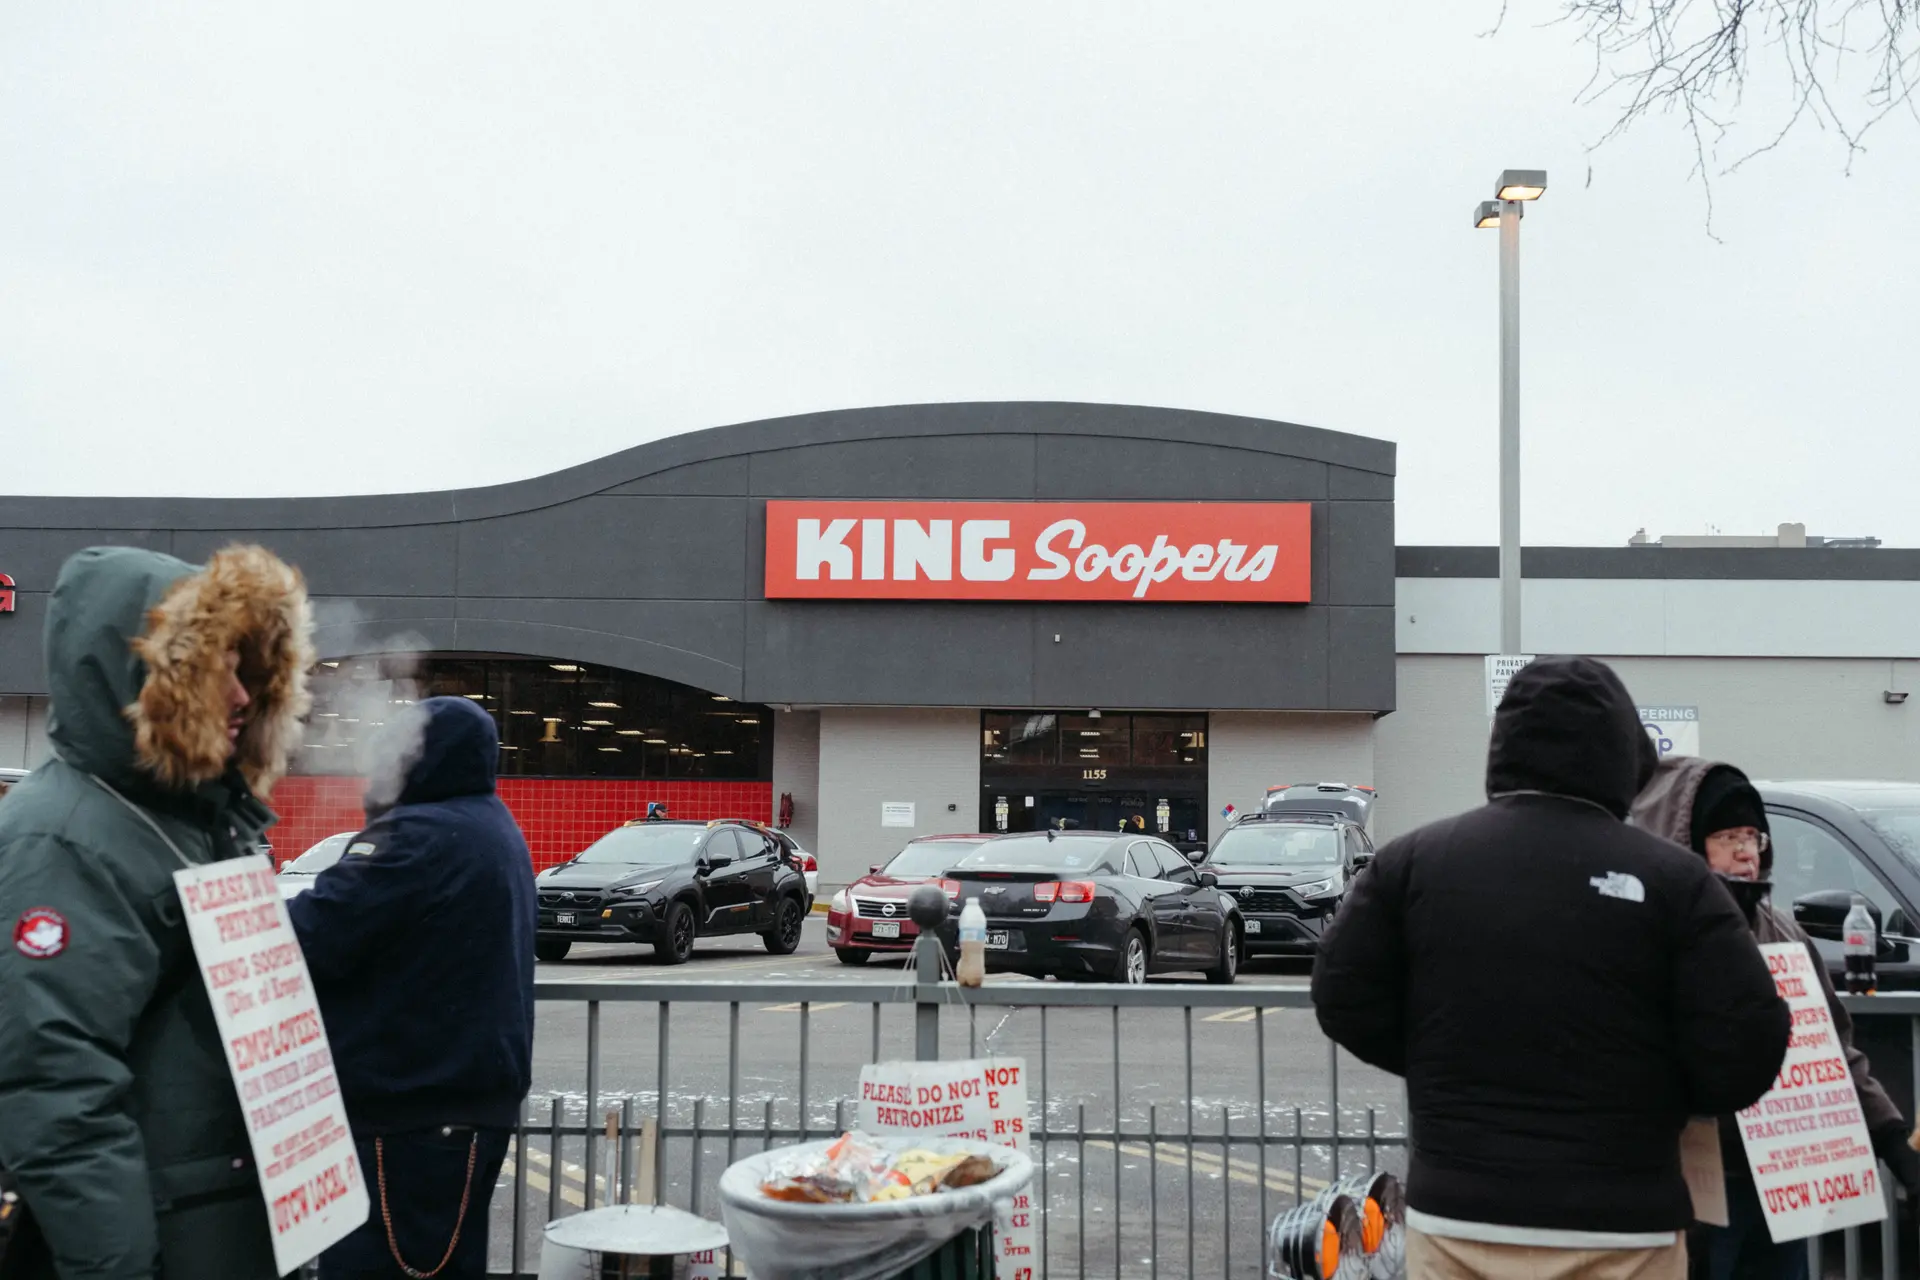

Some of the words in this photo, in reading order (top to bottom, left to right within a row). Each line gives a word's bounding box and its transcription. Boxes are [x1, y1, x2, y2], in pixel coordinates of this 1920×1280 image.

[796, 519, 1015, 581] KING
[1027, 519, 1278, 598] Soopers
[1640, 709, 1695, 719] FERING
[1083, 770, 1107, 779] 1155
[1768, 954, 1788, 974] DO
[985, 1067, 1019, 1086] NOT
[863, 1082, 912, 1105] PLEASE
[917, 1085, 942, 1105] DO
[948, 1078, 980, 1100] NOT
[877, 1104, 964, 1128] PATRONIZE
[1745, 1115, 1818, 1141] PRACTICE
[1818, 1108, 1861, 1129] STRIKE
[1764, 1182, 1812, 1214] UFCW
[1813, 1173, 1860, 1204] LOCAL
